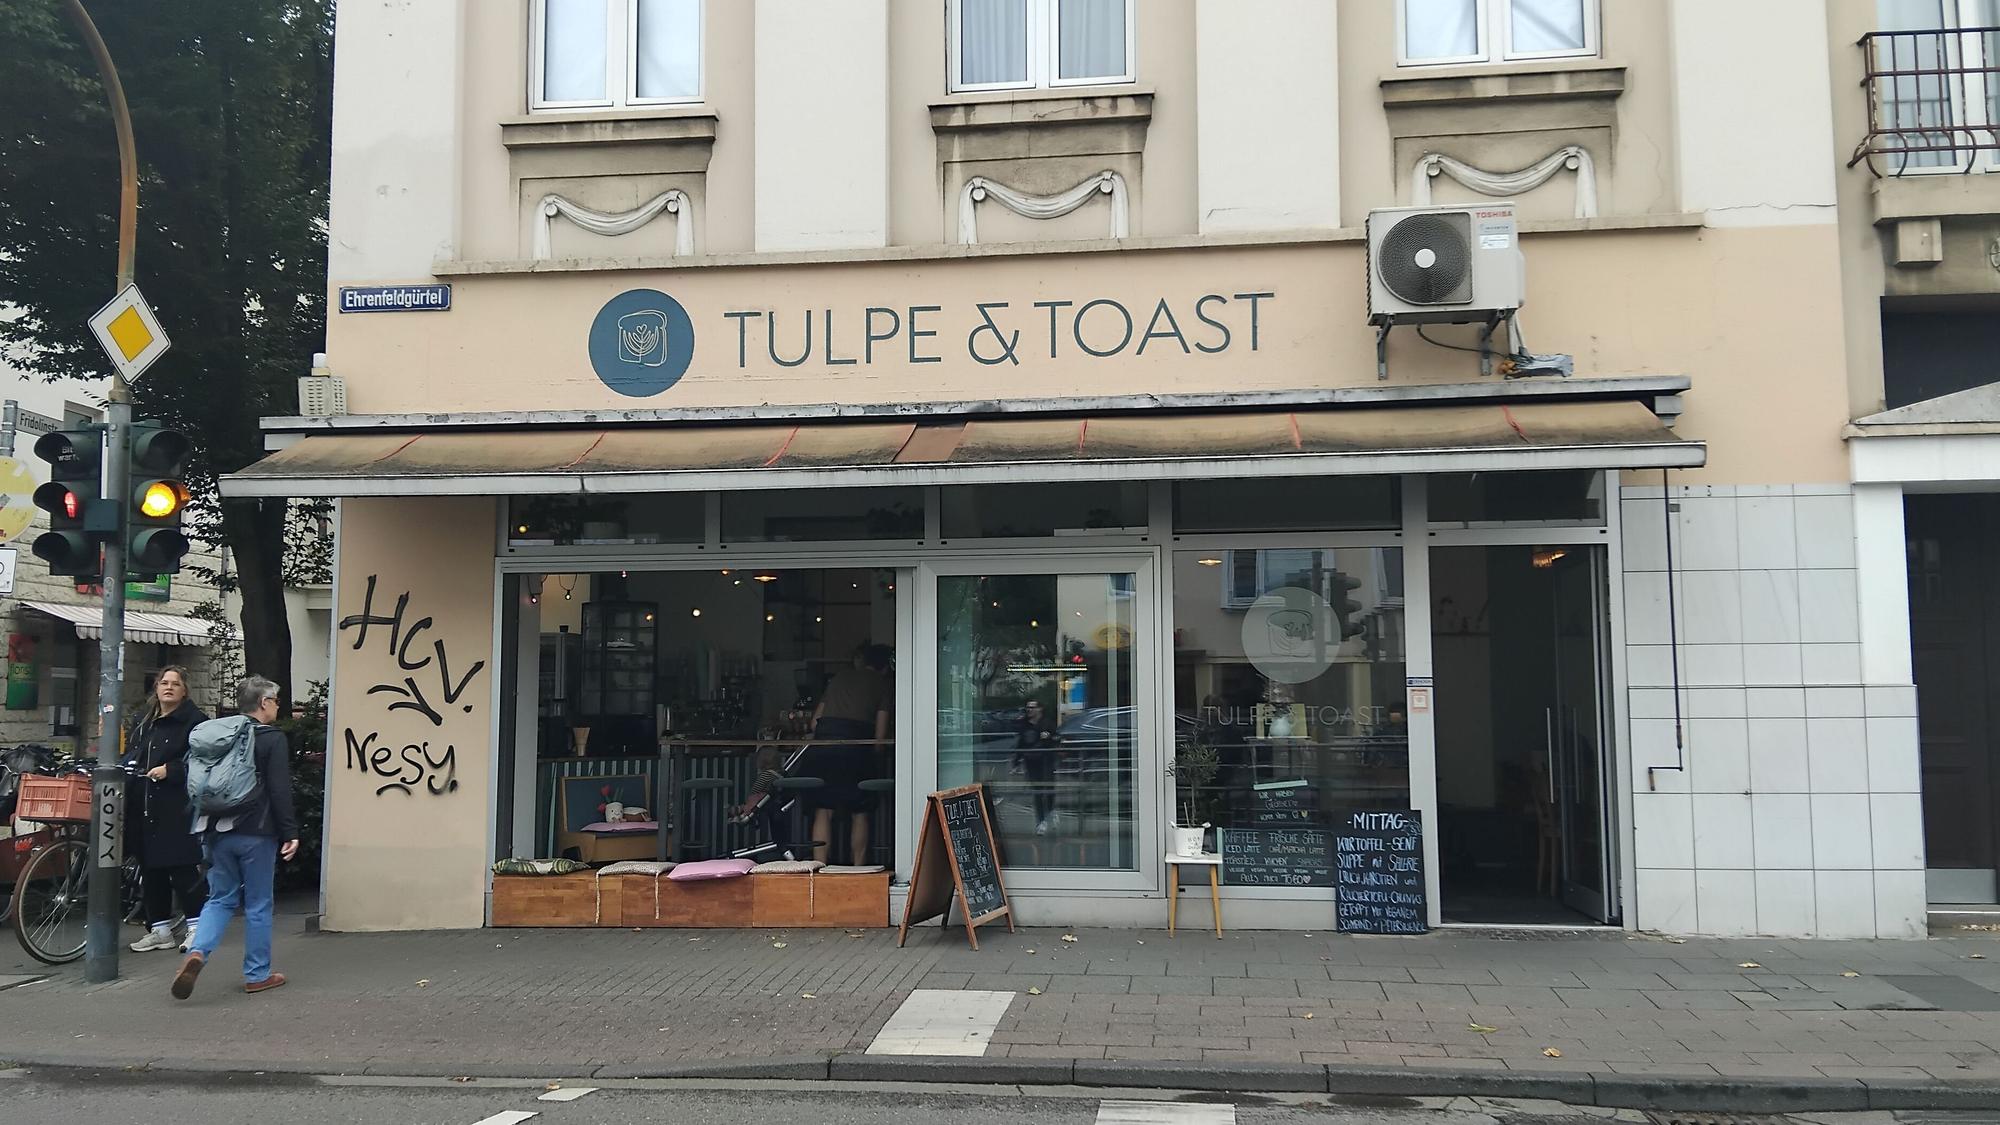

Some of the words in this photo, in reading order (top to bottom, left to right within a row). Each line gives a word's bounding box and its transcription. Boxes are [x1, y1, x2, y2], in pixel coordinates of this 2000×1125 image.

[1476, 210, 1513, 219] TOSHIBA
[345, 288, 442, 308] Ehrenfeldgürtel
[723, 306, 942, 368] TULPE
[968, 302, 1020, 366] &
[1033, 292, 1275, 359] TOAST
[1306, 705, 1384, 725] TOAST
[100, 785, 115, 861] SONY
[1224, 832, 1261, 844] KAFFEE
[1268, 831, 1299, 845] FRISCHE
[1336, 852, 1366, 869] SUPPE
